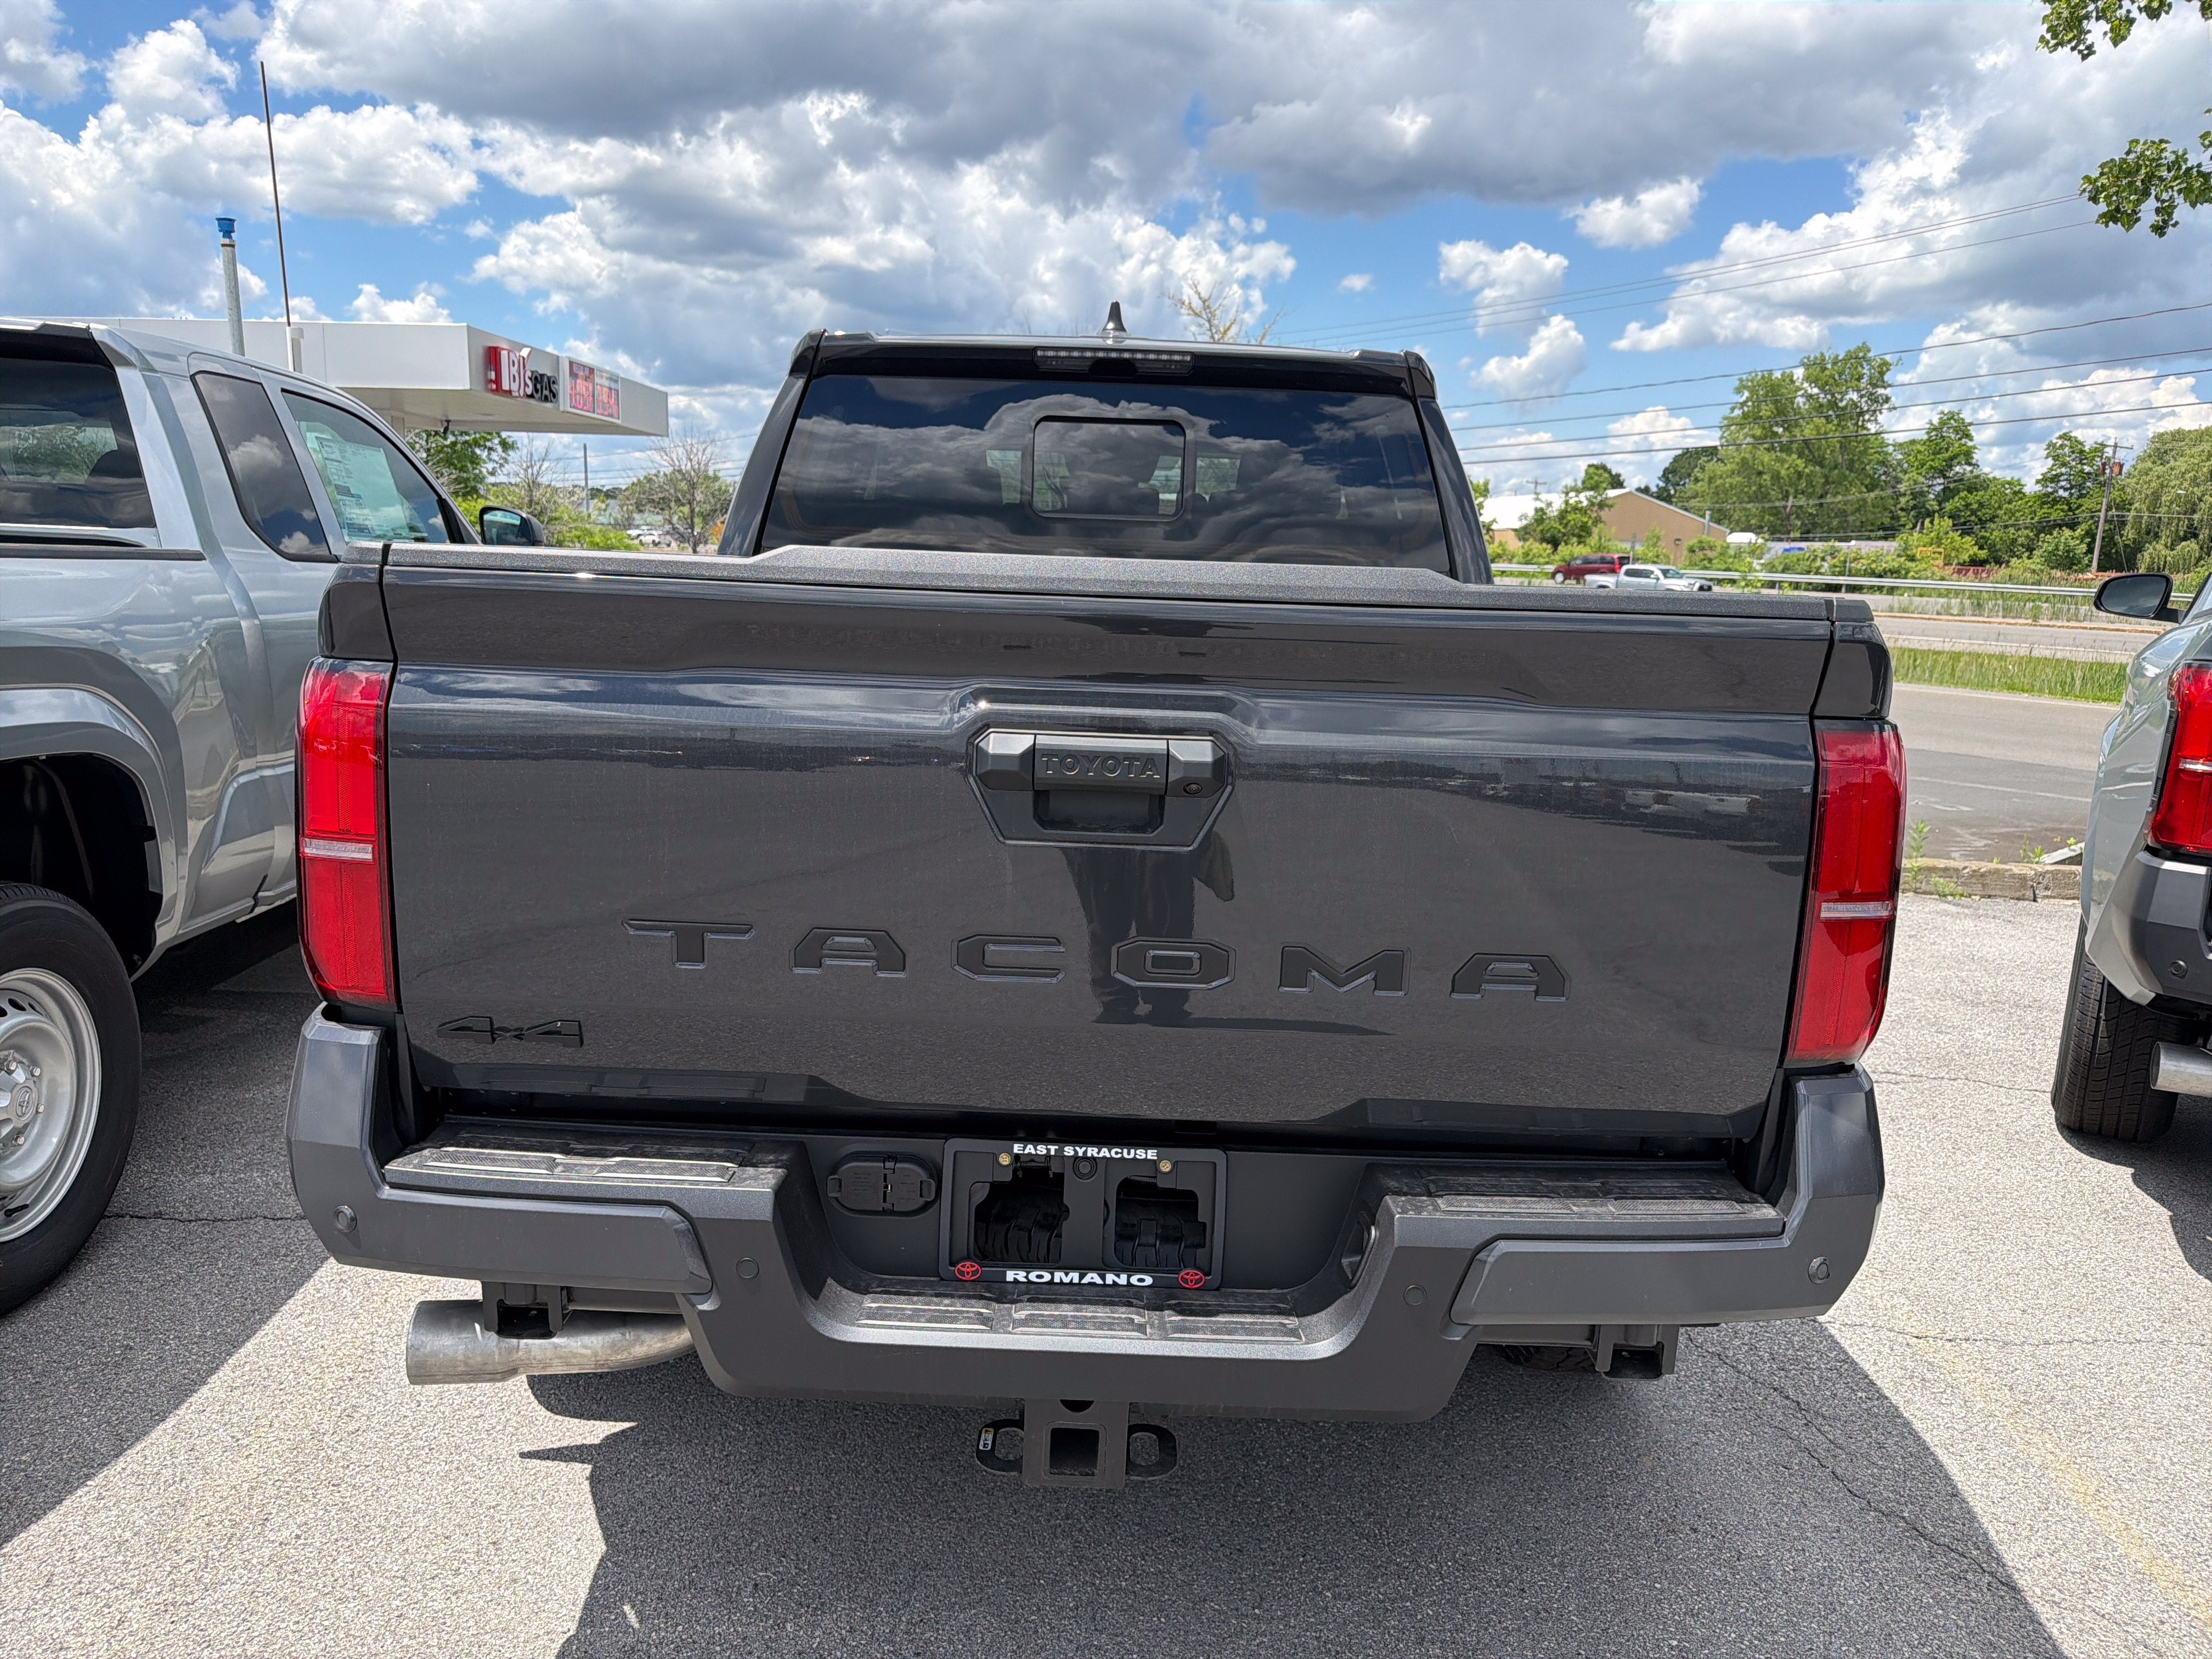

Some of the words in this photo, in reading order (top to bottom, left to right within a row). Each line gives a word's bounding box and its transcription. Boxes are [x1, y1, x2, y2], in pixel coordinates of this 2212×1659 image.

[532, 370, 559, 403] GAS
[1041, 753, 1160, 778] TOYOTA
[622, 917, 1570, 1002] TACOMA
[1013, 1143, 1059, 1156] EAST
[1063, 1146, 1158, 1160] SYRACUSE
[1006, 1269, 1153, 1286] ROMANO
